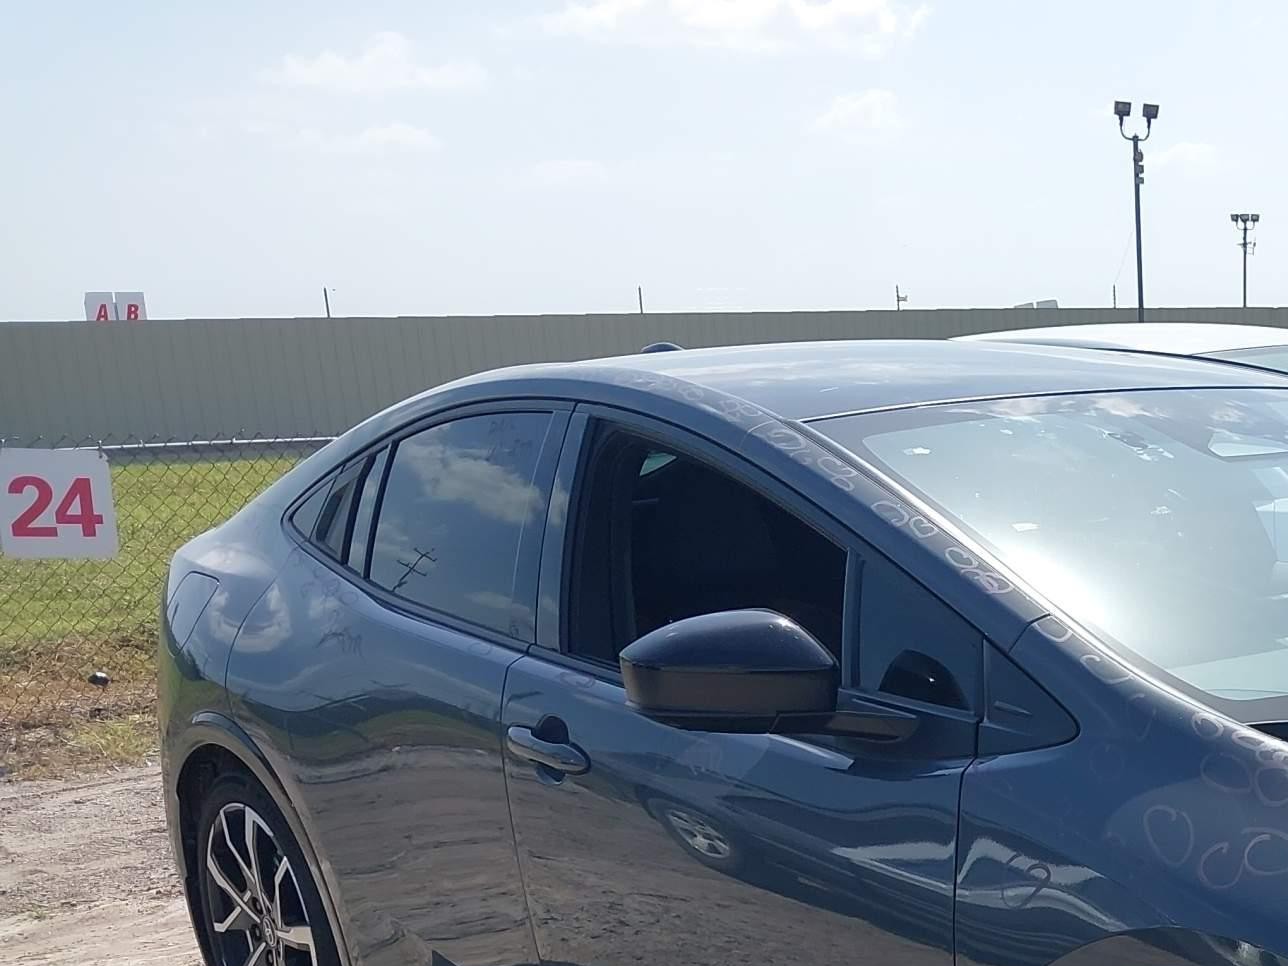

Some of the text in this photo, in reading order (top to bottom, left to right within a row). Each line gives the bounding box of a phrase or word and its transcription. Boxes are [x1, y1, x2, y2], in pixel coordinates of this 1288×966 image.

[96, 303, 108, 321] A
[127, 303, 139, 321] B
[7, 475, 104, 537] 24
